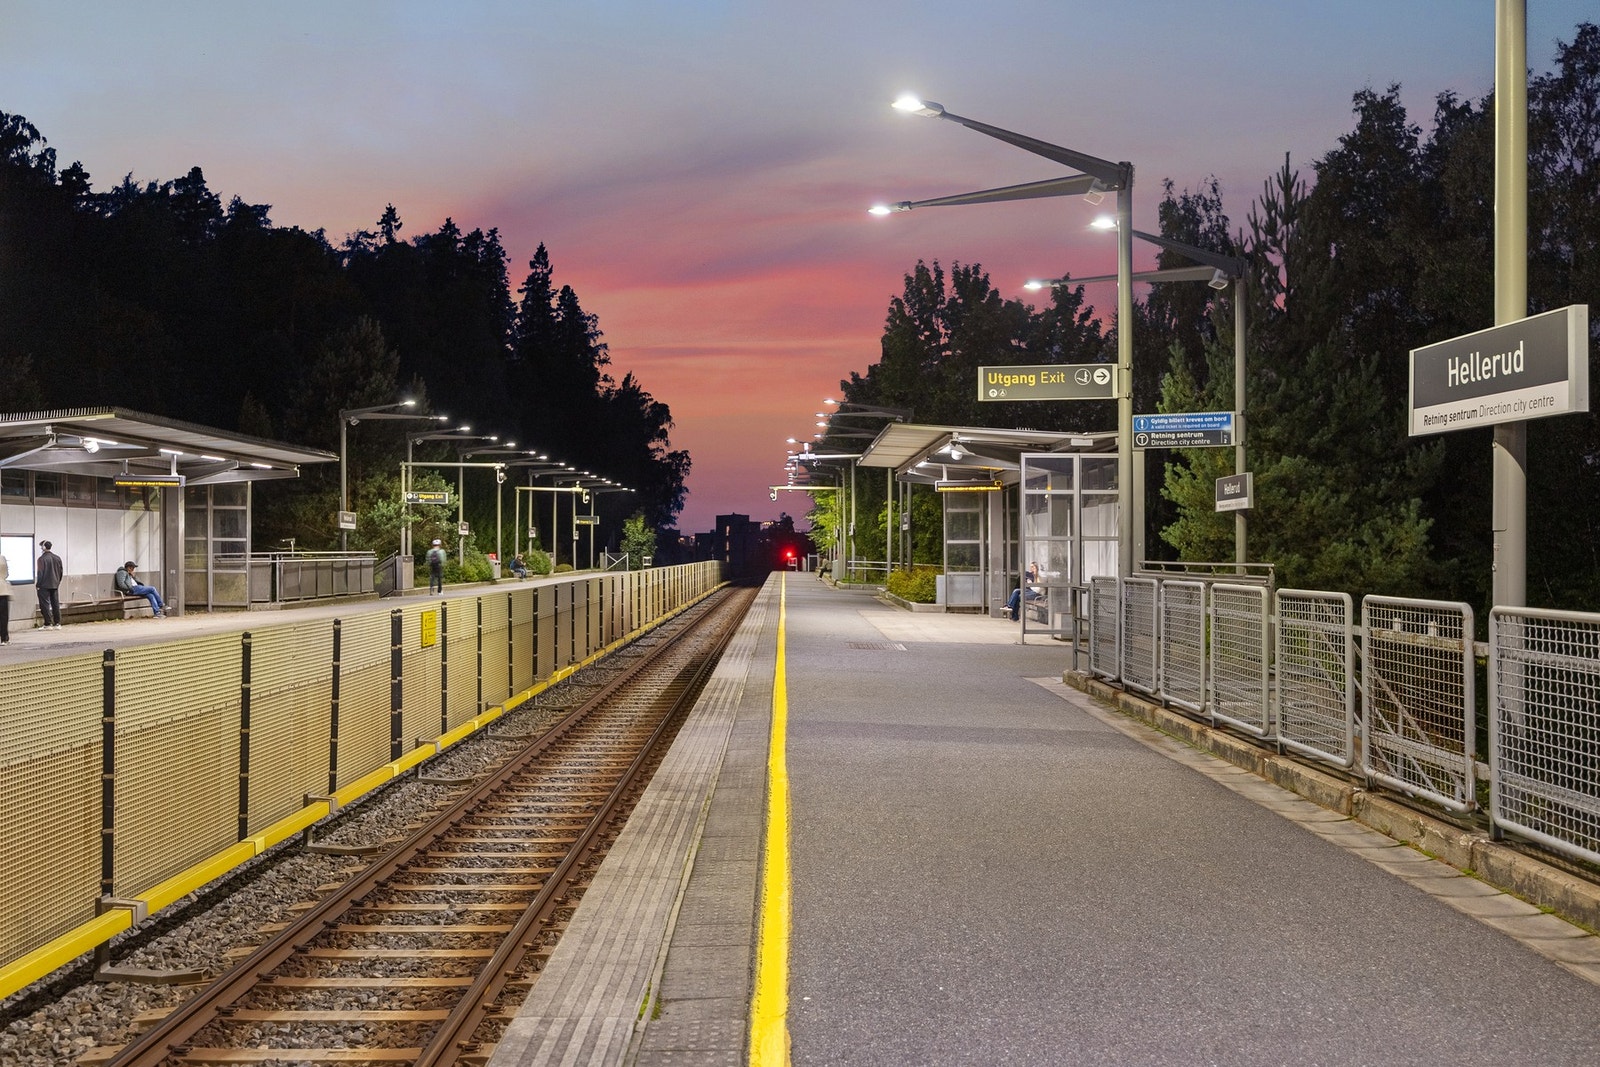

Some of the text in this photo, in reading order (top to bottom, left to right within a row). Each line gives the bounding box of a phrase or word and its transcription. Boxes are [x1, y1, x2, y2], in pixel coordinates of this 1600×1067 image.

[988, 371, 1065, 387] Utgang Exit
[1448, 340, 1524, 387] Hellerud
[1423, 395, 1555, 427] Retning sentrum Direction city centre
